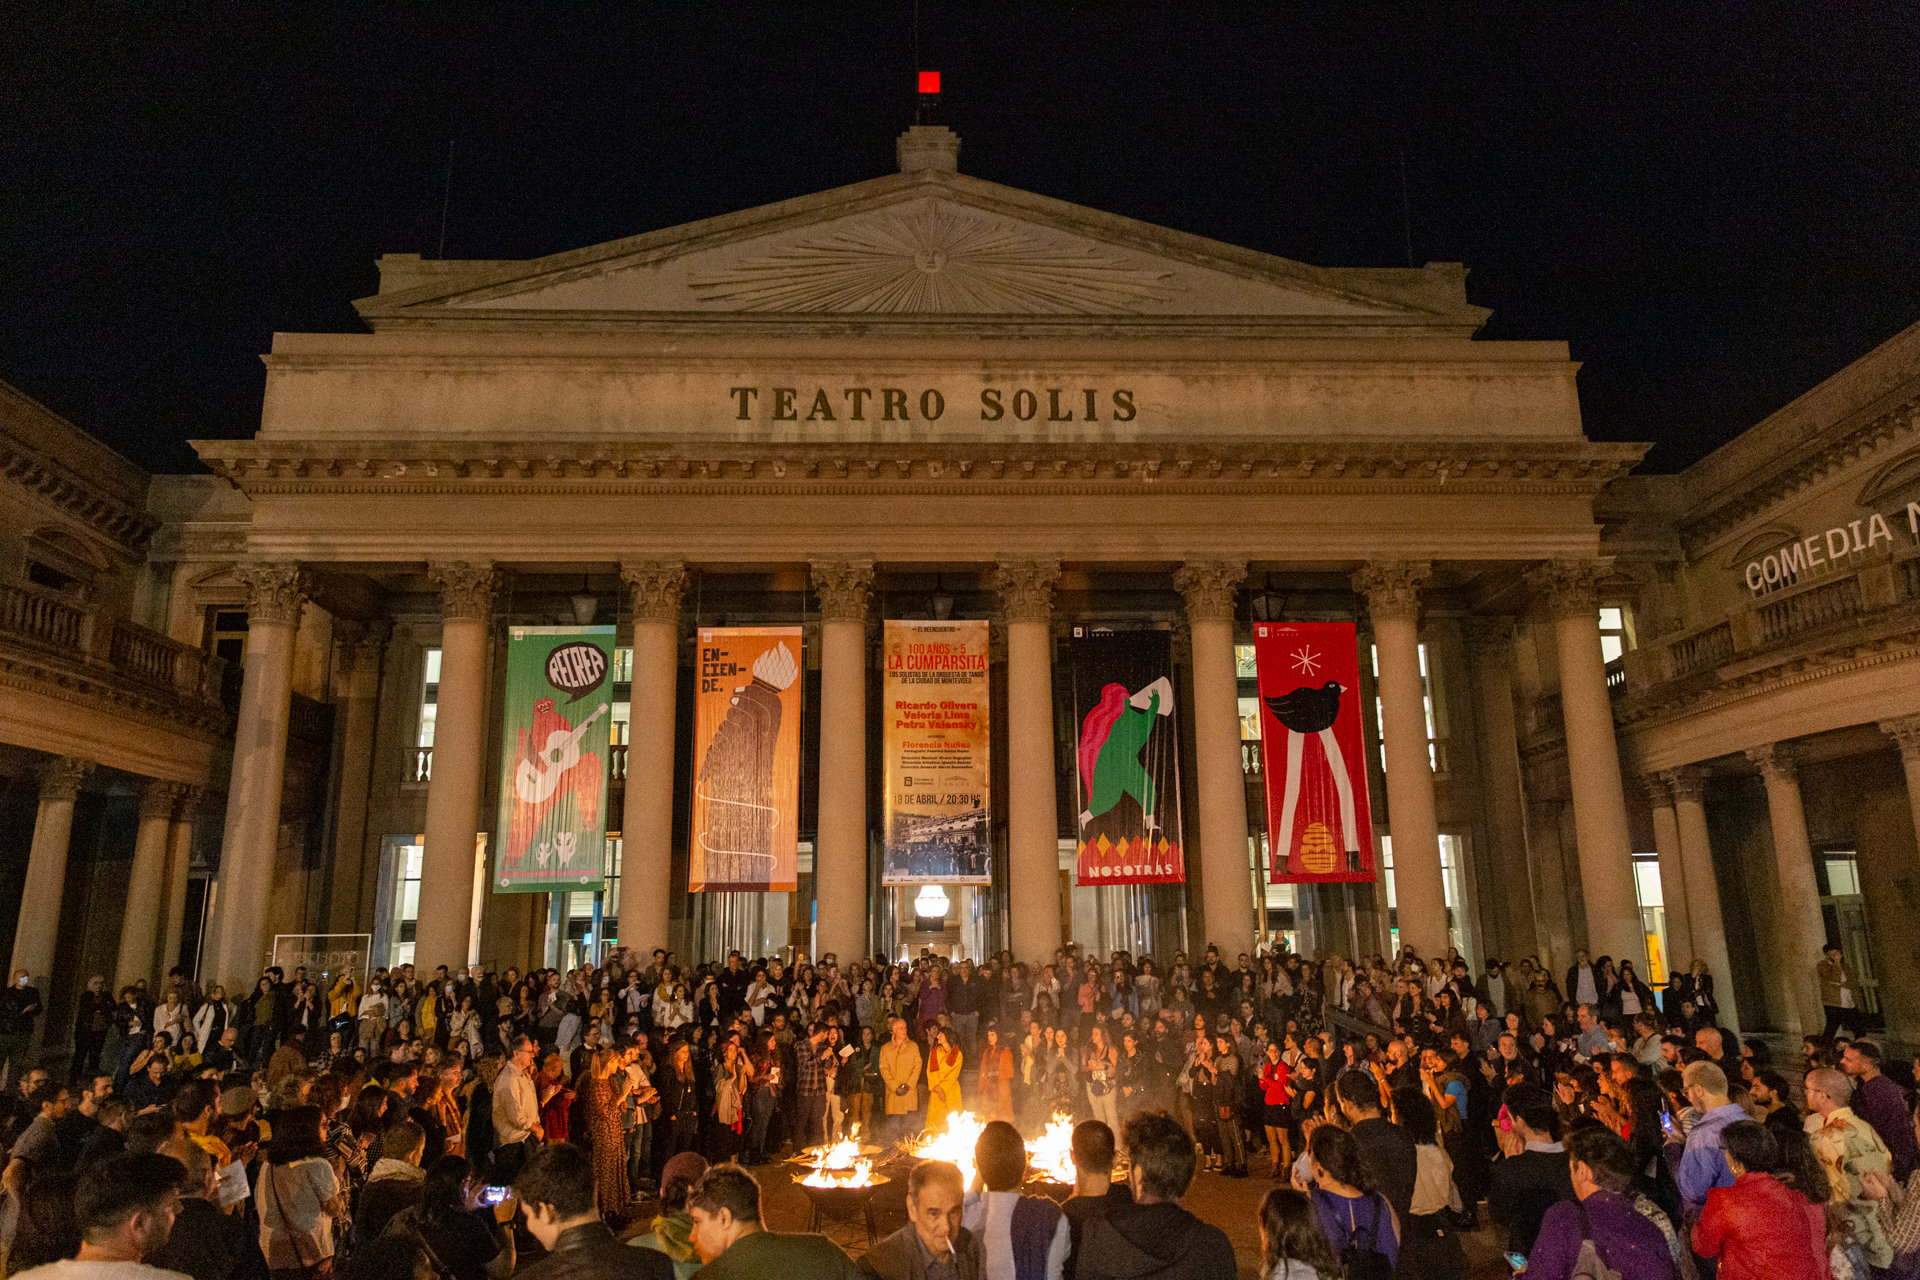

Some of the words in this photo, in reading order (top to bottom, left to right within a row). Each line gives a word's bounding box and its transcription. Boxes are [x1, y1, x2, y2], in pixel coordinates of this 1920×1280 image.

[730, 387, 945, 421] TEATRO
[980, 388, 1137, 422] SOLIS
[1745, 513, 1893, 591] COMEDIA
[702, 648, 729, 662] EN-
[909, 643, 924, 655] 100
[927, 641, 950, 655] AÑOS
[549, 646, 604, 688] RECREA
[888, 654, 903, 670] LA
[907, 654, 985, 670] CUMPARSITA
[702, 662, 747, 677] CIEN-
[702, 678, 723, 693] DE.
[895, 701, 937, 710] Ricardo
[939, 701, 978, 710] Olivera
[903, 711, 942, 720] Valeria
[944, 711, 970, 720] Lima
[896, 720, 925, 729] Petru
[928, 720, 977, 730] Valensky
[902, 741, 942, 749] Florencia
[904, 794, 914, 805] DE
[916, 794, 938, 805] ABRIL
[947, 794, 969, 805] 20:30
[1088, 863, 1173, 878] NOSOTRAS
